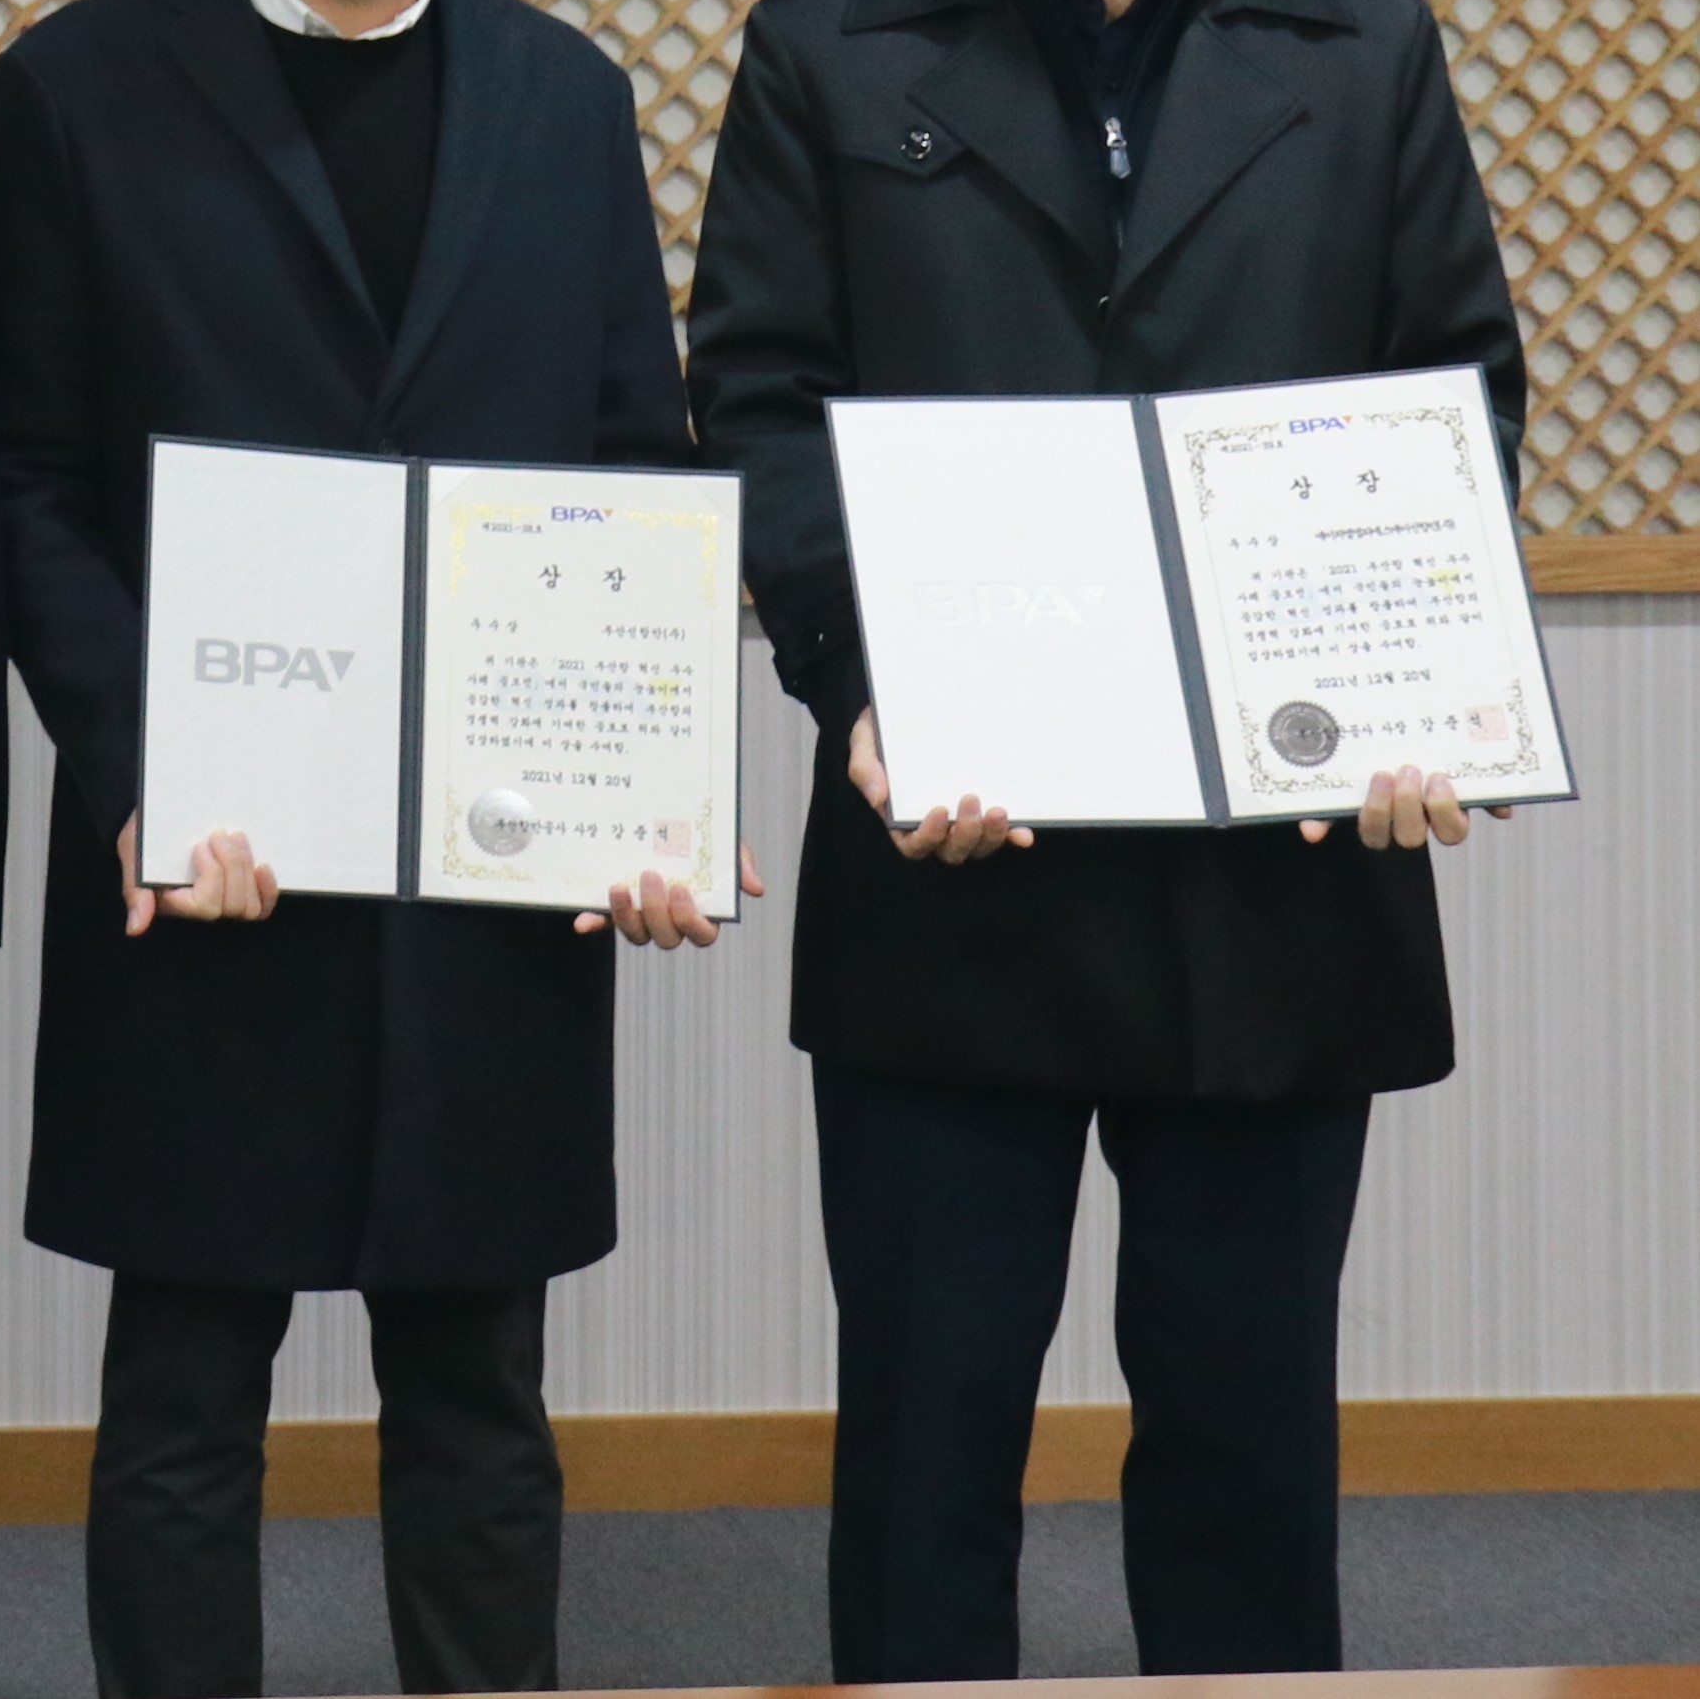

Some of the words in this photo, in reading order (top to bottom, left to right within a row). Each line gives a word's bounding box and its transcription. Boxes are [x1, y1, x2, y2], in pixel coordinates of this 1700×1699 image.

[1289, 417, 1346, 434] BPA
[1290, 475, 1313, 500] 상
[1357, 469, 1380, 494] 장
[551, 506, 604, 523] BPA
[539, 564, 562, 590] 상
[603, 567, 626, 593] 장
[193, 638, 335, 692] BPA
[522, 770, 563, 784] 2021년
